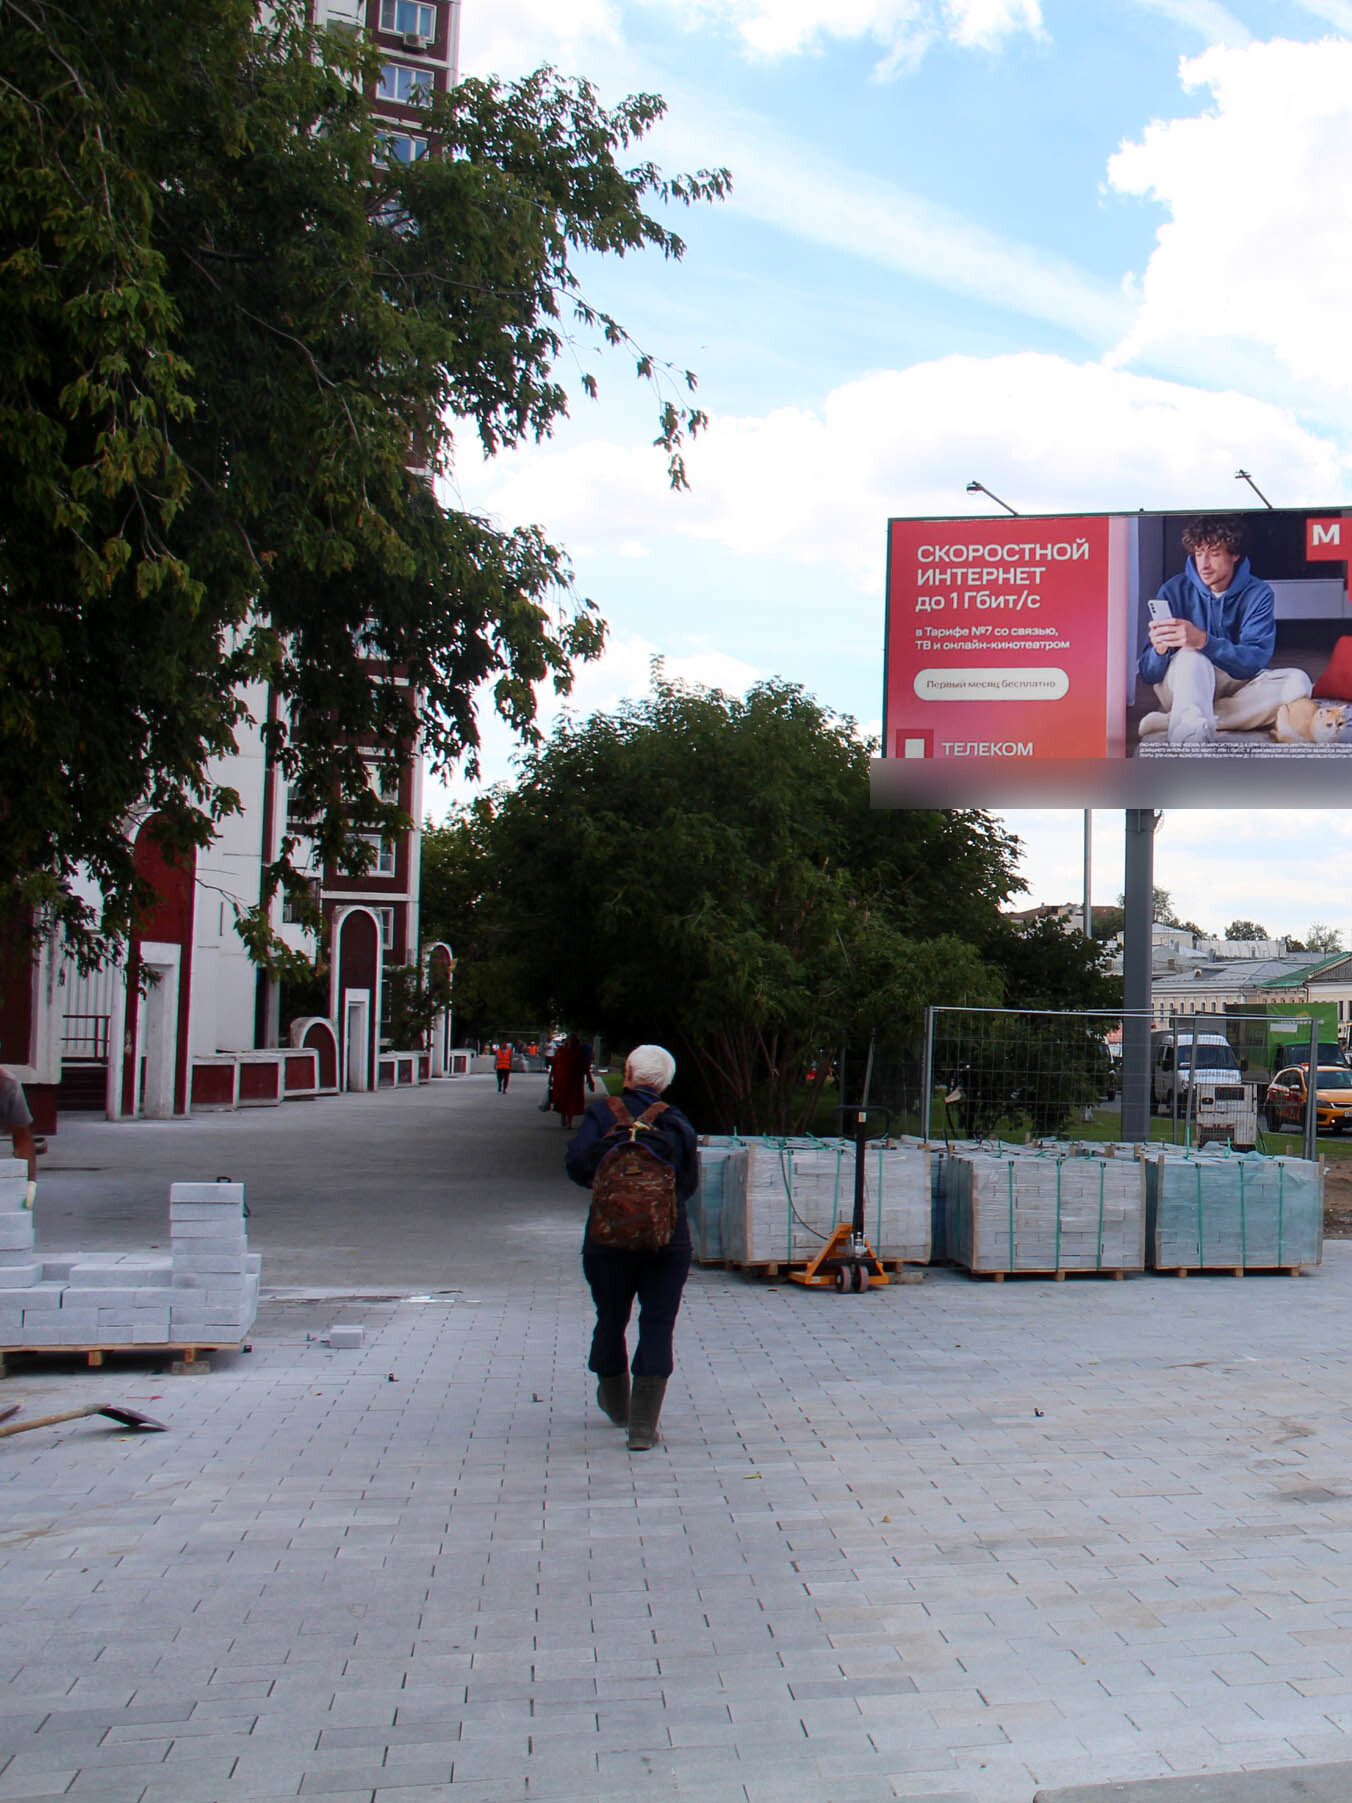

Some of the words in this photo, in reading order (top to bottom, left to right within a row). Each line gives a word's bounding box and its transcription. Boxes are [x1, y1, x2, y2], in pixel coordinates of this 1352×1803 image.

[917, 538, 1089, 562] СКОРОСТНОЙ
[917, 566, 1046, 586] ИНТЕРНЕТ
[915, 595, 945, 612] до
[950, 591, 958, 609] 1
[964, 589, 1041, 611] Гбит/с
[915, 629, 923, 637] в
[925, 626, 970, 639] Тарифе
[971, 625, 993, 636] №7
[994, 627, 1010, 636] со
[1011, 627, 1059, 638] связью,
[915, 640, 931, 650] ТВ
[933, 642, 941, 650] и
[943, 639, 1071, 652] онлайн-кинотеатром
[967, 681, 1000, 690] месяц
[1001, 679, 1057, 689] бесплатно
[941, 741, 1034, 757] ТЕЛЕКОМ
